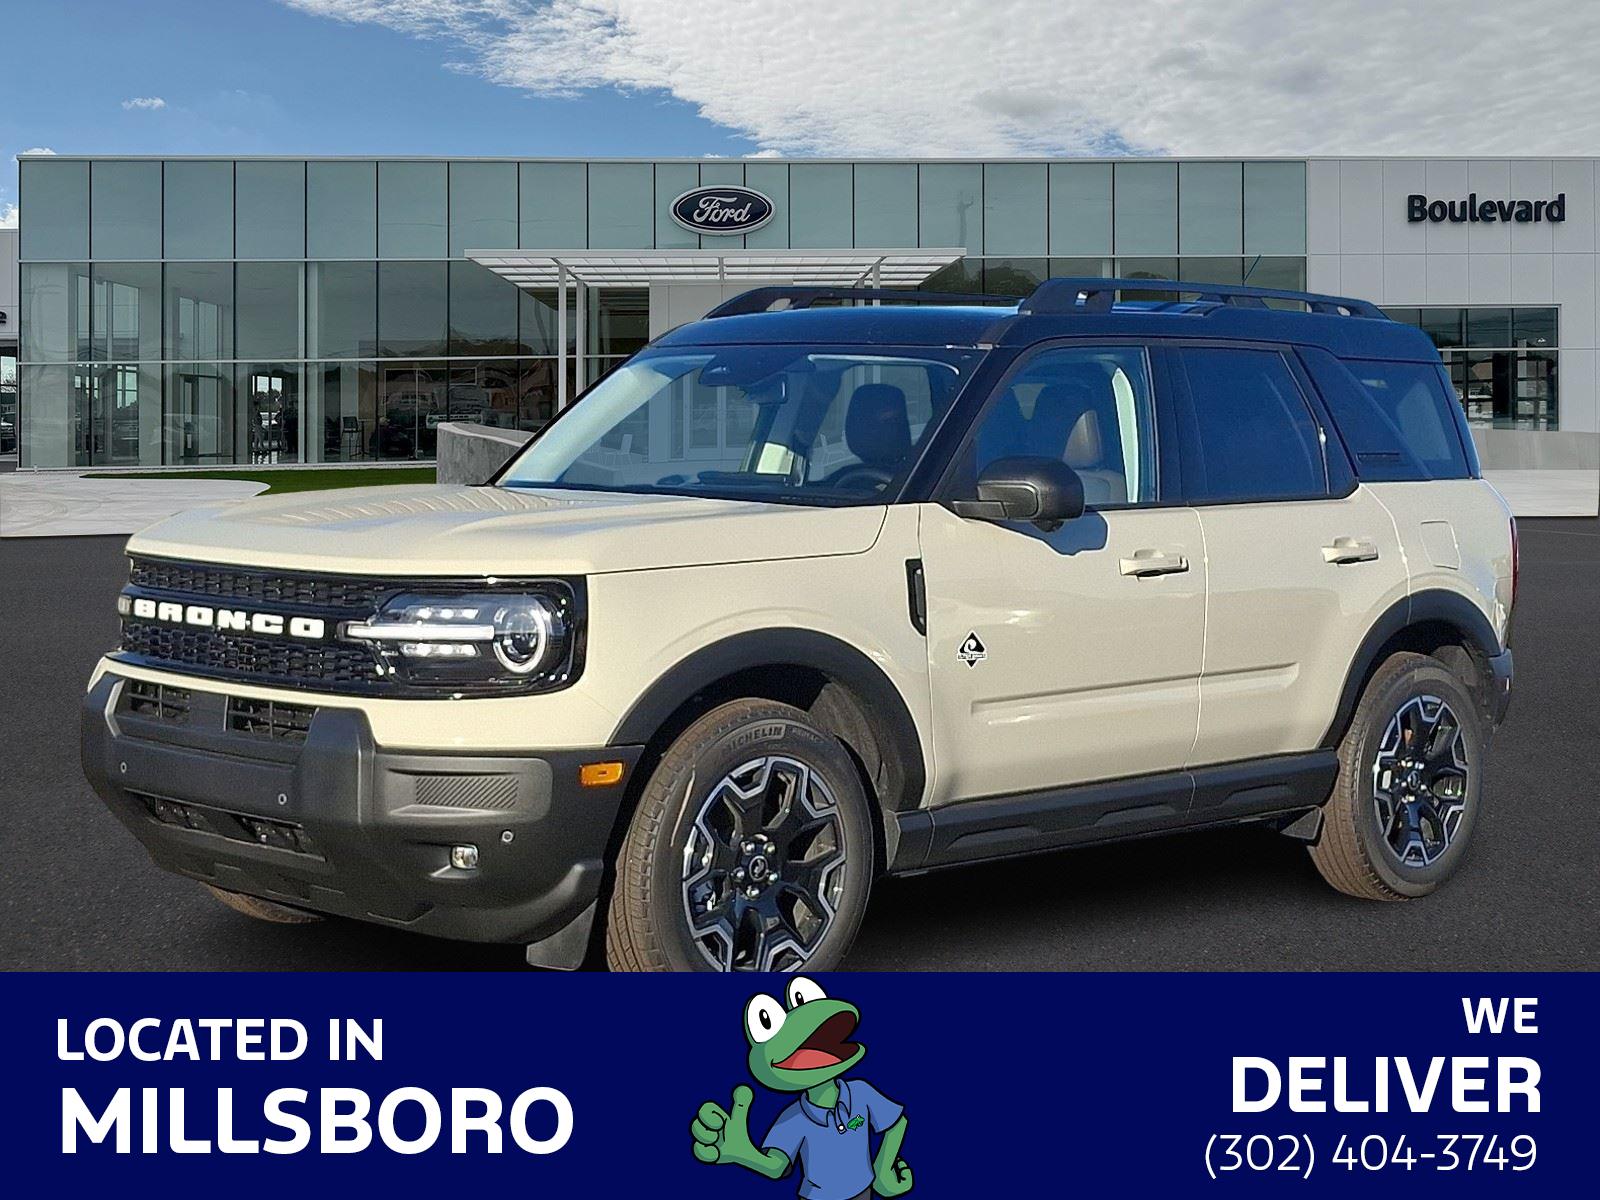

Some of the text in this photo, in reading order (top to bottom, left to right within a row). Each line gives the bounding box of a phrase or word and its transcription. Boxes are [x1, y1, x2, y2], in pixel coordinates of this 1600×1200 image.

[693, 196, 752, 223] Ford
[1408, 193, 1566, 223] Boulevard
[133, 598, 325, 639] BRONCO
